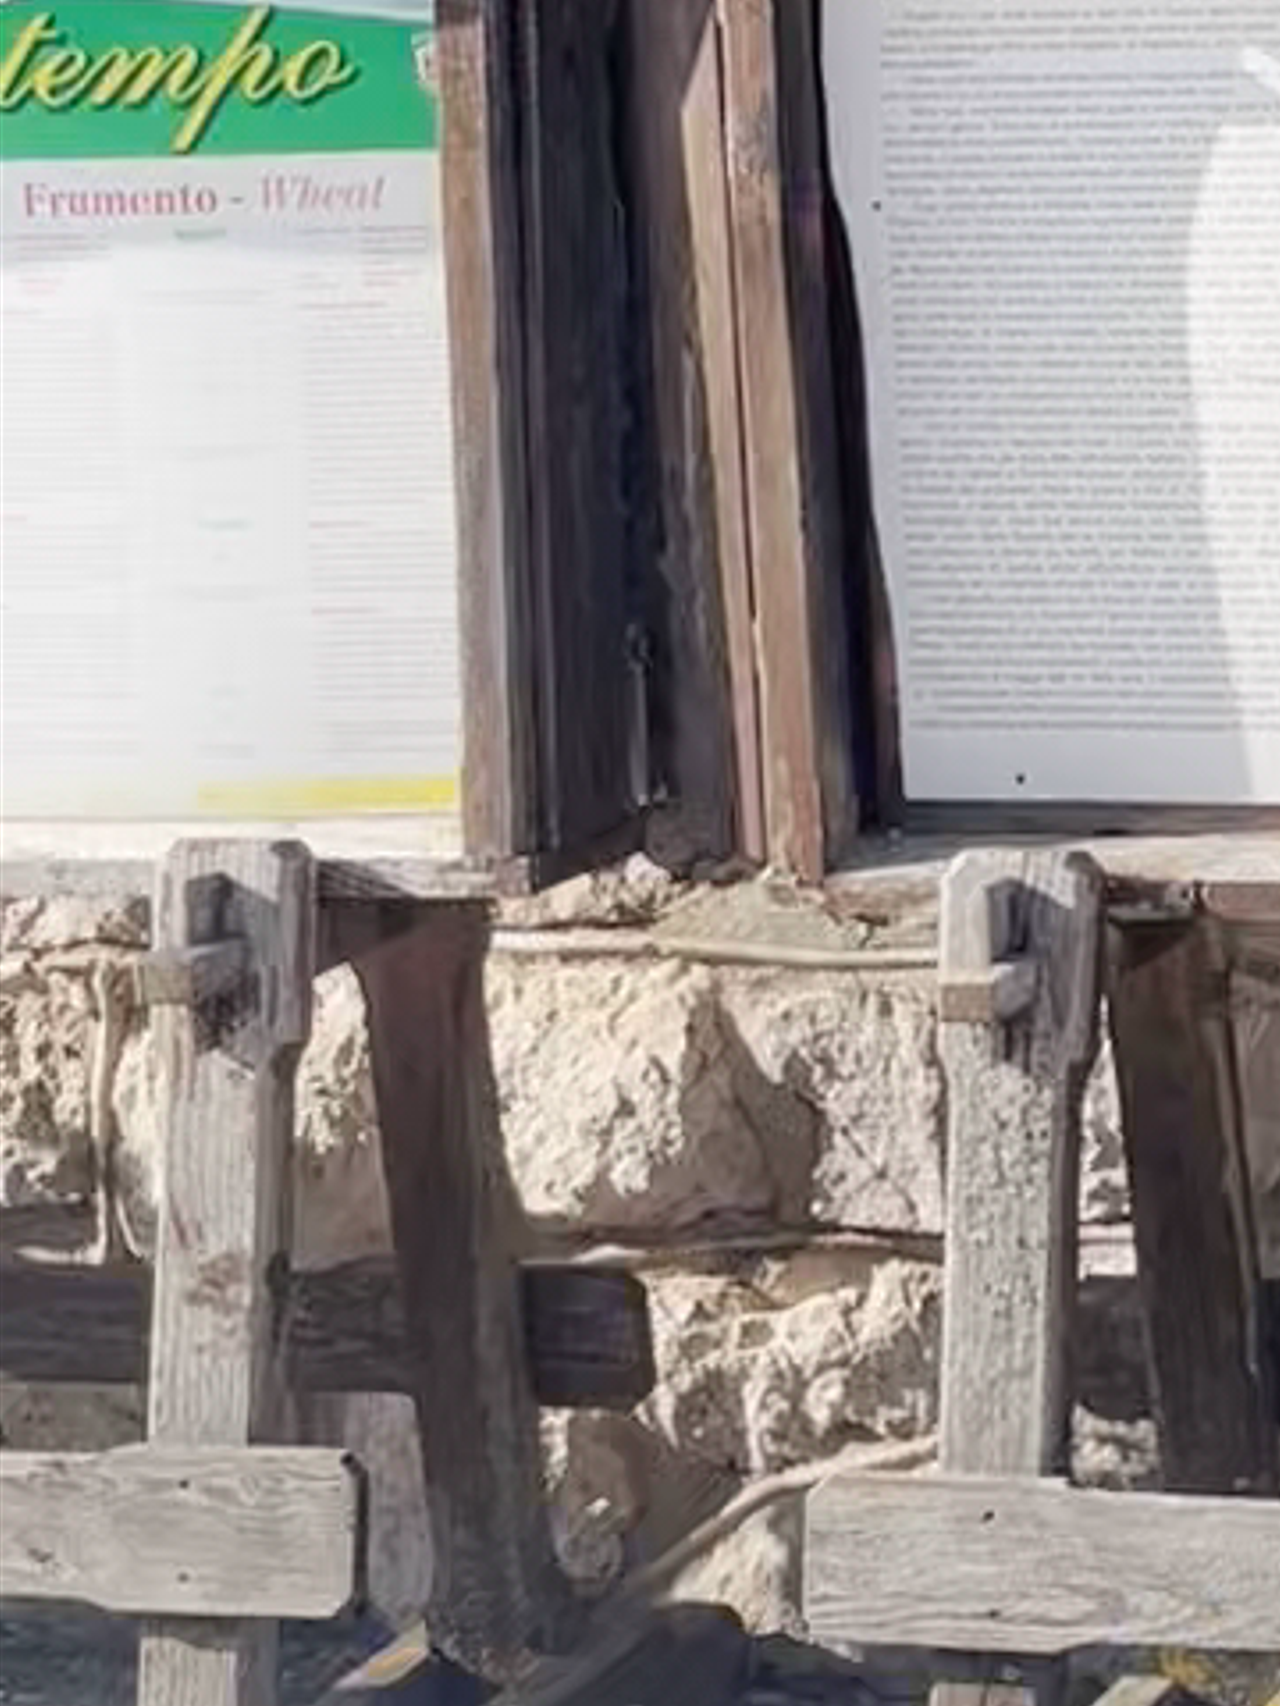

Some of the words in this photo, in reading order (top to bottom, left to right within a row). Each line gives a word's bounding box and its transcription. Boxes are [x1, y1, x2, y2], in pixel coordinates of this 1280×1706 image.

[0, 2, 362, 155] tempo
[22, 180, 219, 219] Frumento
[260, 174, 385, 213] Wheat
